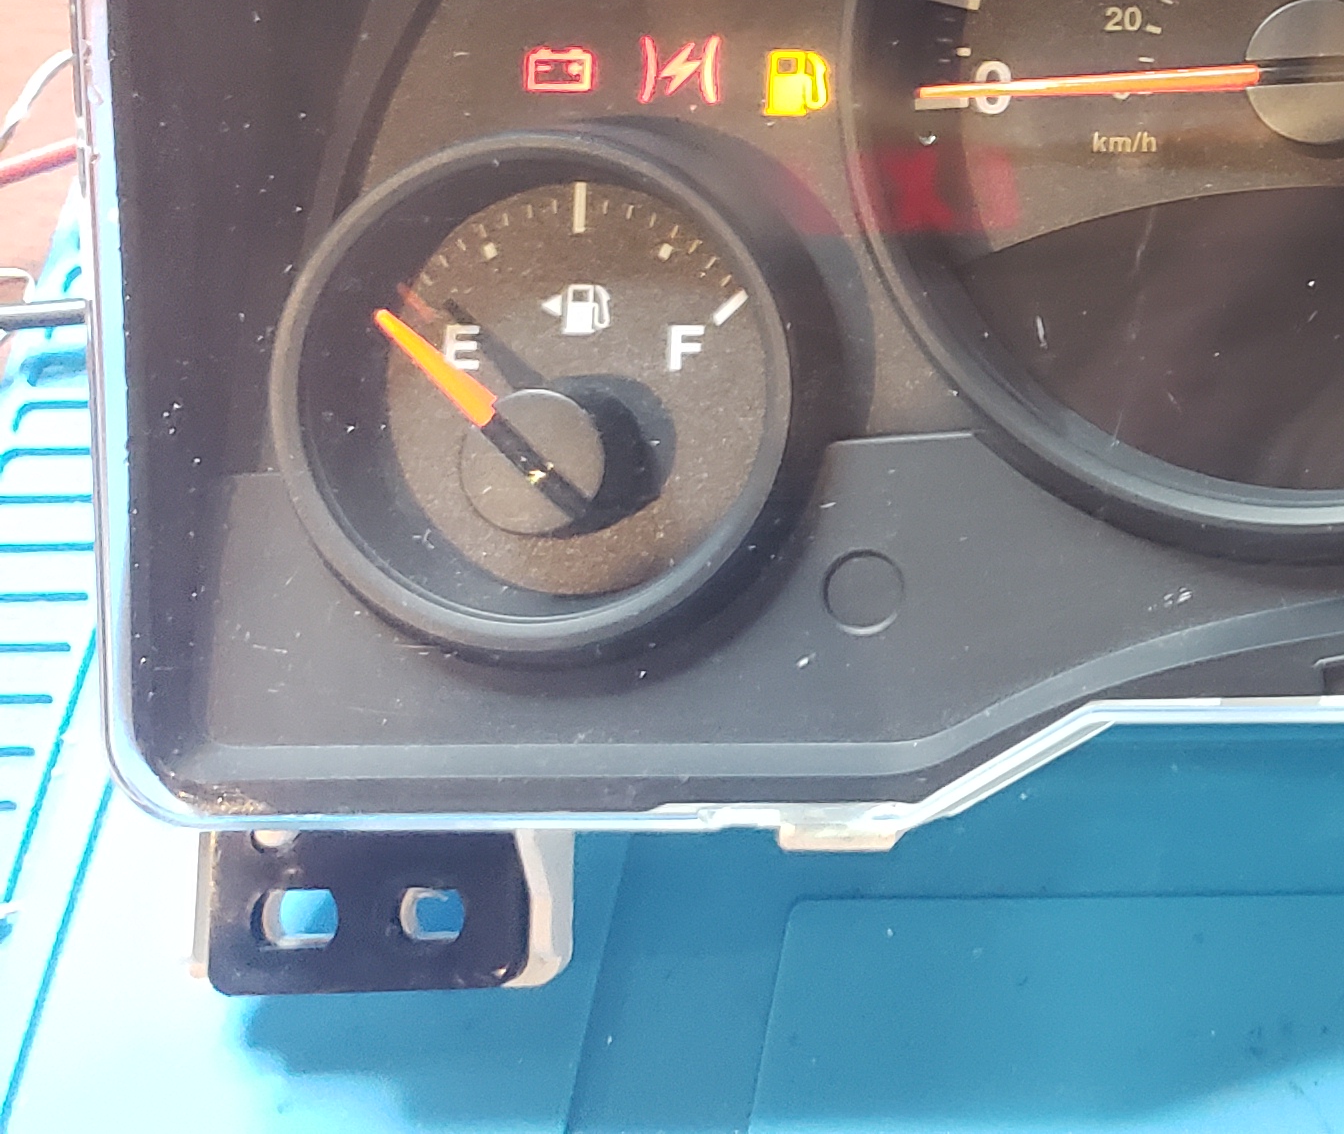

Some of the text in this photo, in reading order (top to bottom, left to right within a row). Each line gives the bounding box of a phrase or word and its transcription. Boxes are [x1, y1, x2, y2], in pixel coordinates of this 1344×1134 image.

[1103, 6, 1143, 33] 20
[975, 60, 1013, 115] 0
[1091, 130, 1158, 155] km/h
[442, 324, 481, 371] E
[667, 324, 706, 372] F
